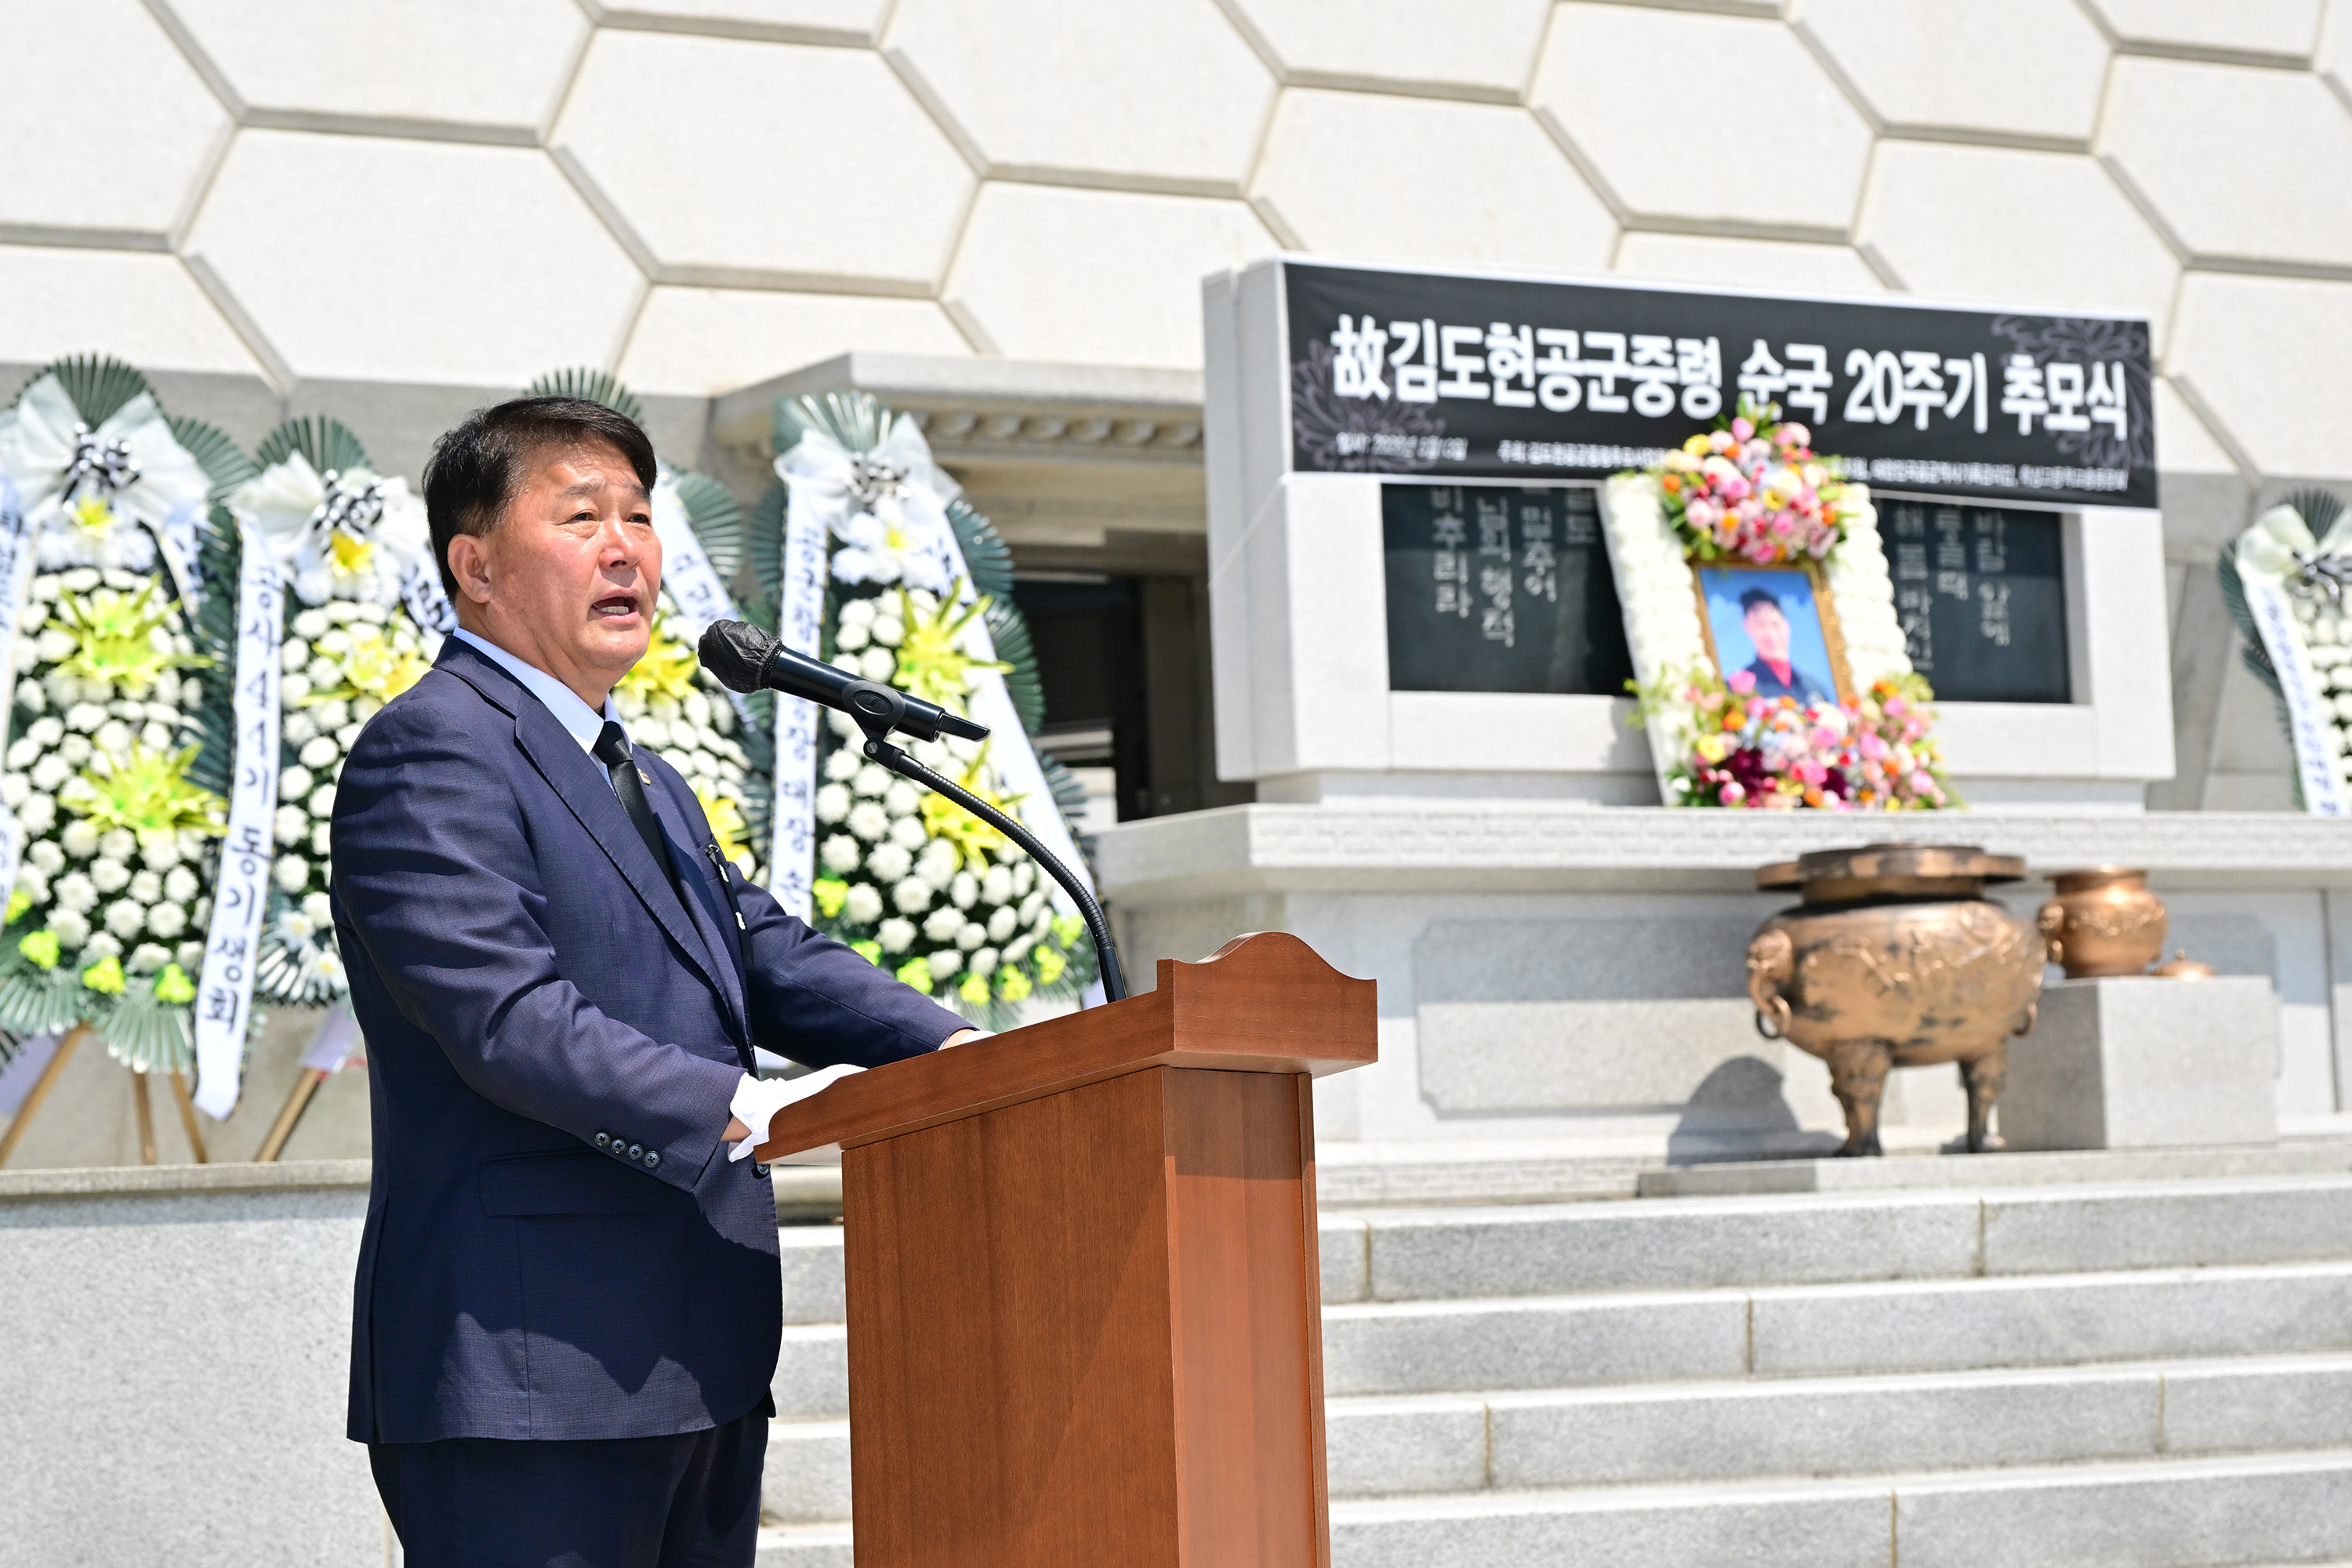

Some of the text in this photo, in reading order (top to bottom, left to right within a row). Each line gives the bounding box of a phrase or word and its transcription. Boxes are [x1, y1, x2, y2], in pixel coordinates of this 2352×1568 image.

[1737, 339, 1833, 426] 순국
[1843, 348, 1988, 434] 20주기
[2001, 354, 2129, 441] 추모식
